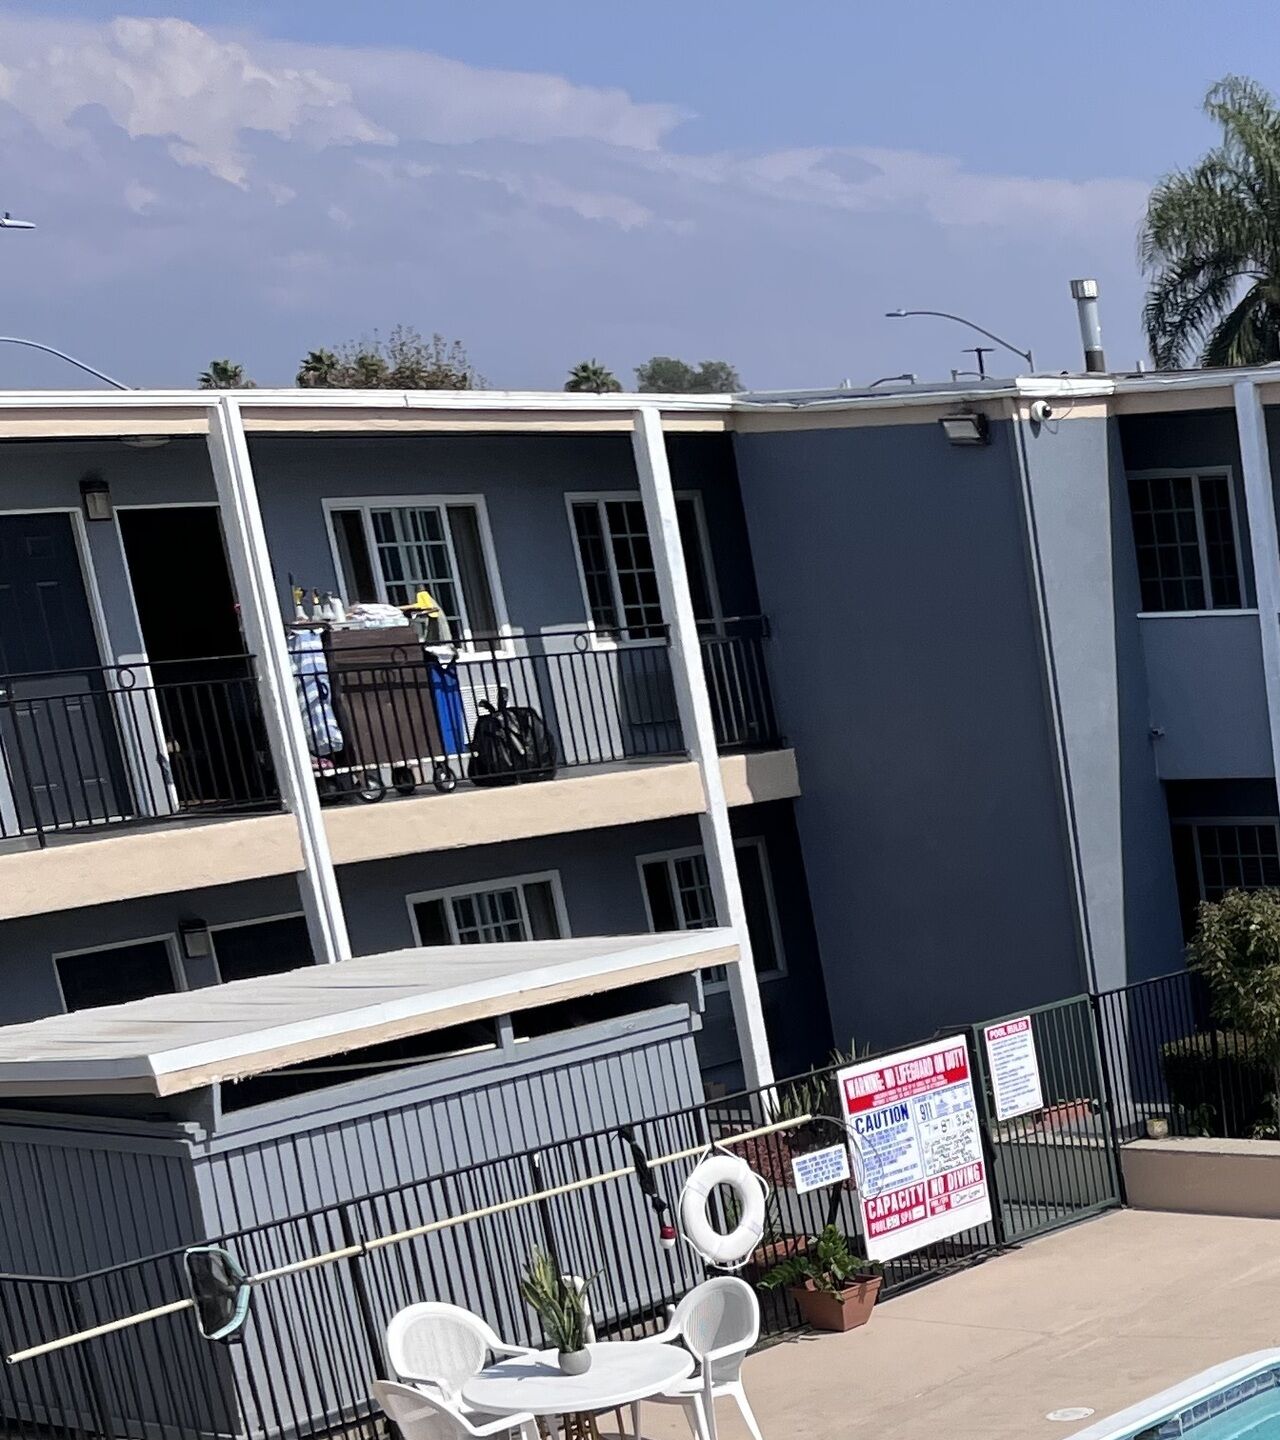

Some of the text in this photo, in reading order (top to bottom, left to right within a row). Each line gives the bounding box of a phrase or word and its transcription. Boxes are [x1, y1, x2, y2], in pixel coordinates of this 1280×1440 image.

[896, 1057, 934, 1086] LIFEGUARD
[944, 1048, 965, 1071] DUTY
[854, 1102, 910, 1134] CAUTION
[919, 1102, 934, 1121] 911
[930, 1164, 981, 1197] NO DIVING
[867, 1182, 925, 1220] CAPACITY
[871, 1219, 887, 1235] POOL
[900, 1209, 913, 1225] SPA
